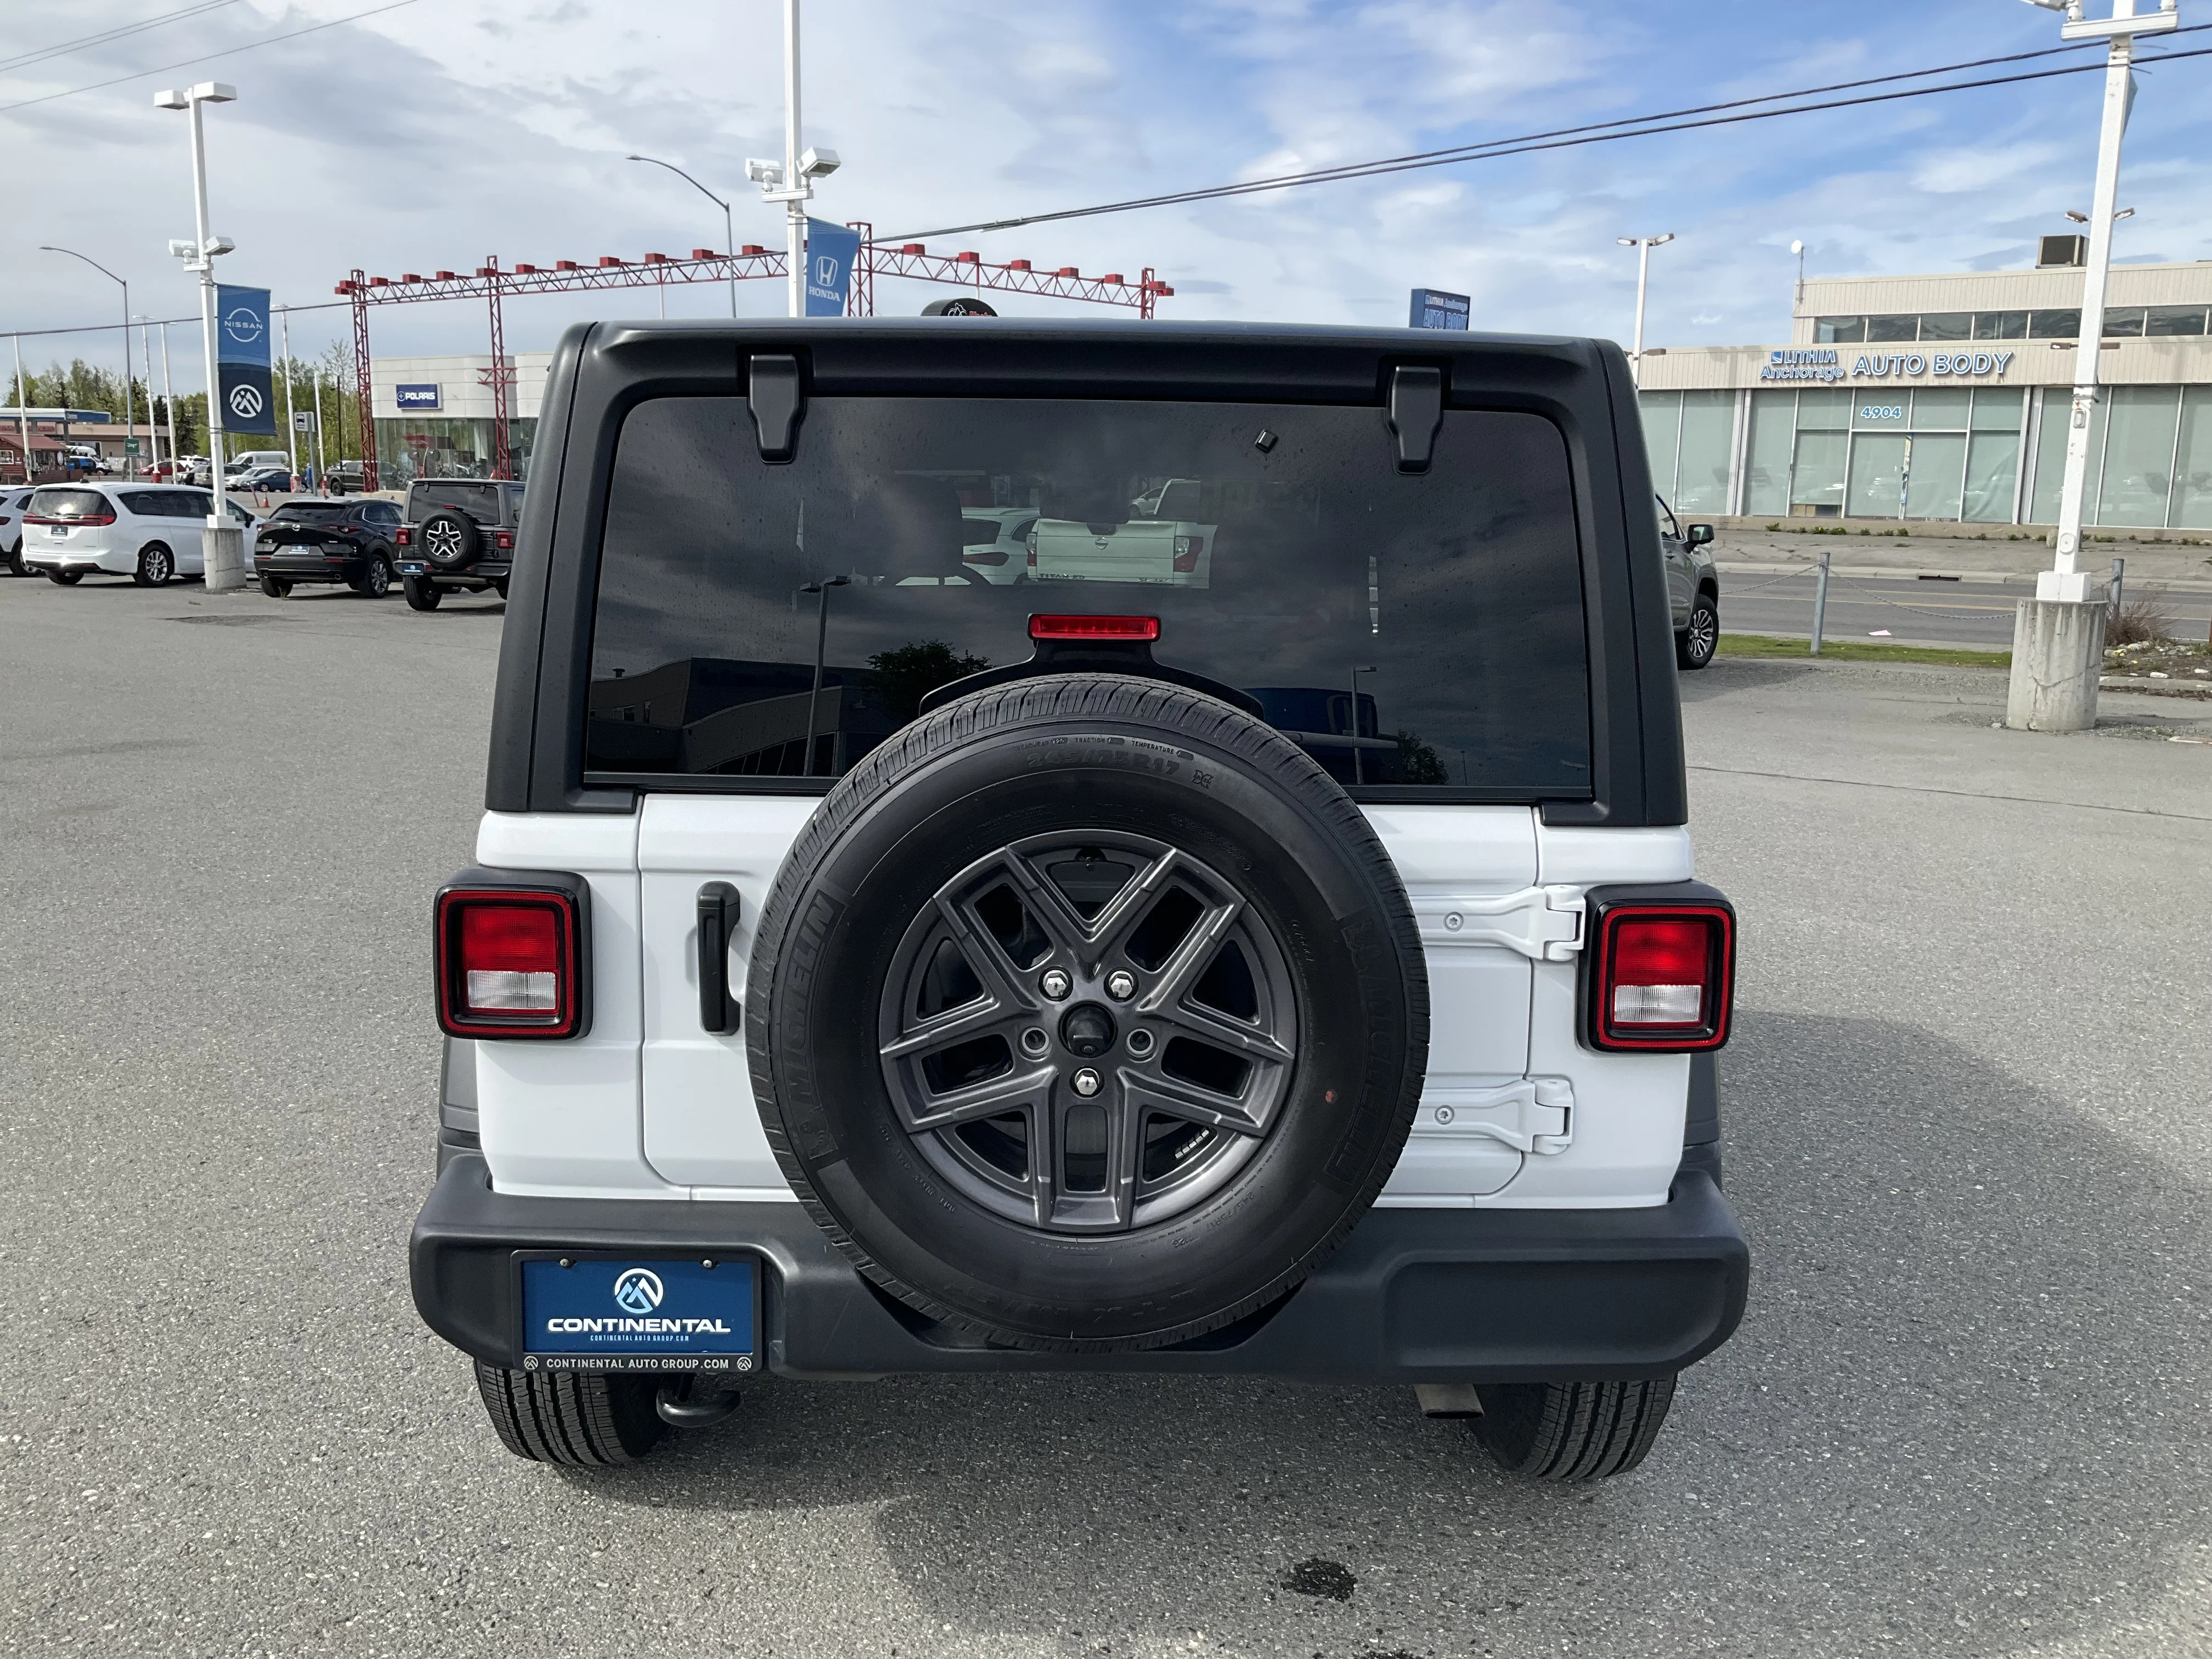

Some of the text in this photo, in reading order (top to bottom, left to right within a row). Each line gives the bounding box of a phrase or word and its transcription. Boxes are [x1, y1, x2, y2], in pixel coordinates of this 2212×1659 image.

[809, 285, 840, 301] HONDA
[224, 320, 263, 330] NISSAN
[1423, 308, 1468, 330] AUTO BODY
[1784, 349, 1836, 364] LITHIA
[1851, 352, 2013, 376] AUTO BODY
[1759, 365, 1844, 381] Anchorage
[405, 392, 436, 400] POLARIS
[1860, 406, 1901, 419] 4904
[1131, 741, 1175, 755] TEMPERATURE
[782, 893, 834, 1103] MICHELIN
[548, 1318, 731, 1333] CONTINENTAL
[546, 1358, 624, 1368] CONTINENTAL
[628, 1359, 659, 1368] AUTO
